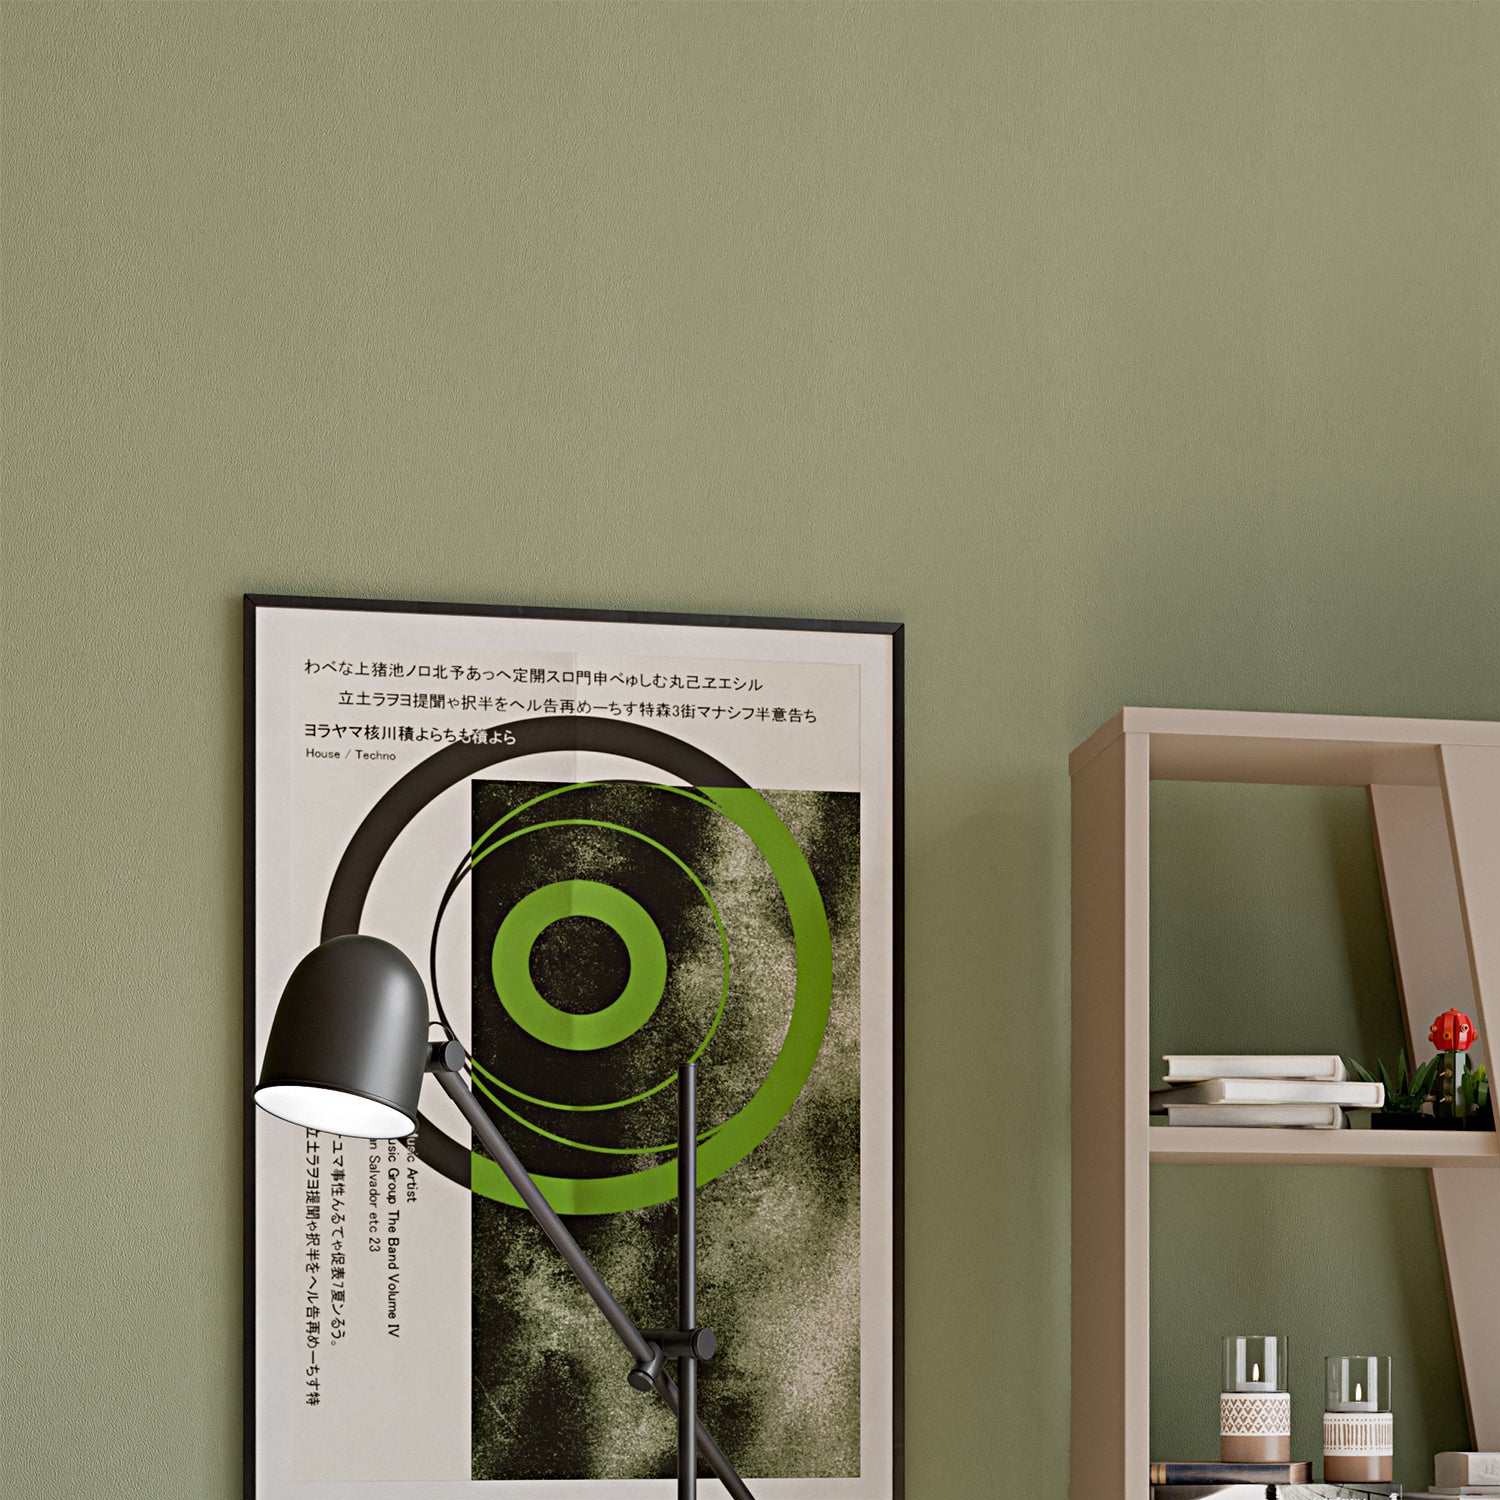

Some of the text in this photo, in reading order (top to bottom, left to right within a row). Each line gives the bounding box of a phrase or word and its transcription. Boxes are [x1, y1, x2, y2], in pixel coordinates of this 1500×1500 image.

[306, 748, 341, 759] House
[355, 749, 396, 761] Techno
[368, 1155, 380, 1209] Salvador
[386, 1168, 400, 1205] Group
[406, 1167, 418, 1203] Artist
[368, 1212, 379, 1233] etc
[387, 1210, 400, 1233] The
[368, 1237, 380, 1253] 23
[387, 1237, 400, 1270] Band
[387, 1273, 400, 1319] Volume
[387, 1323, 400, 1338] IV
